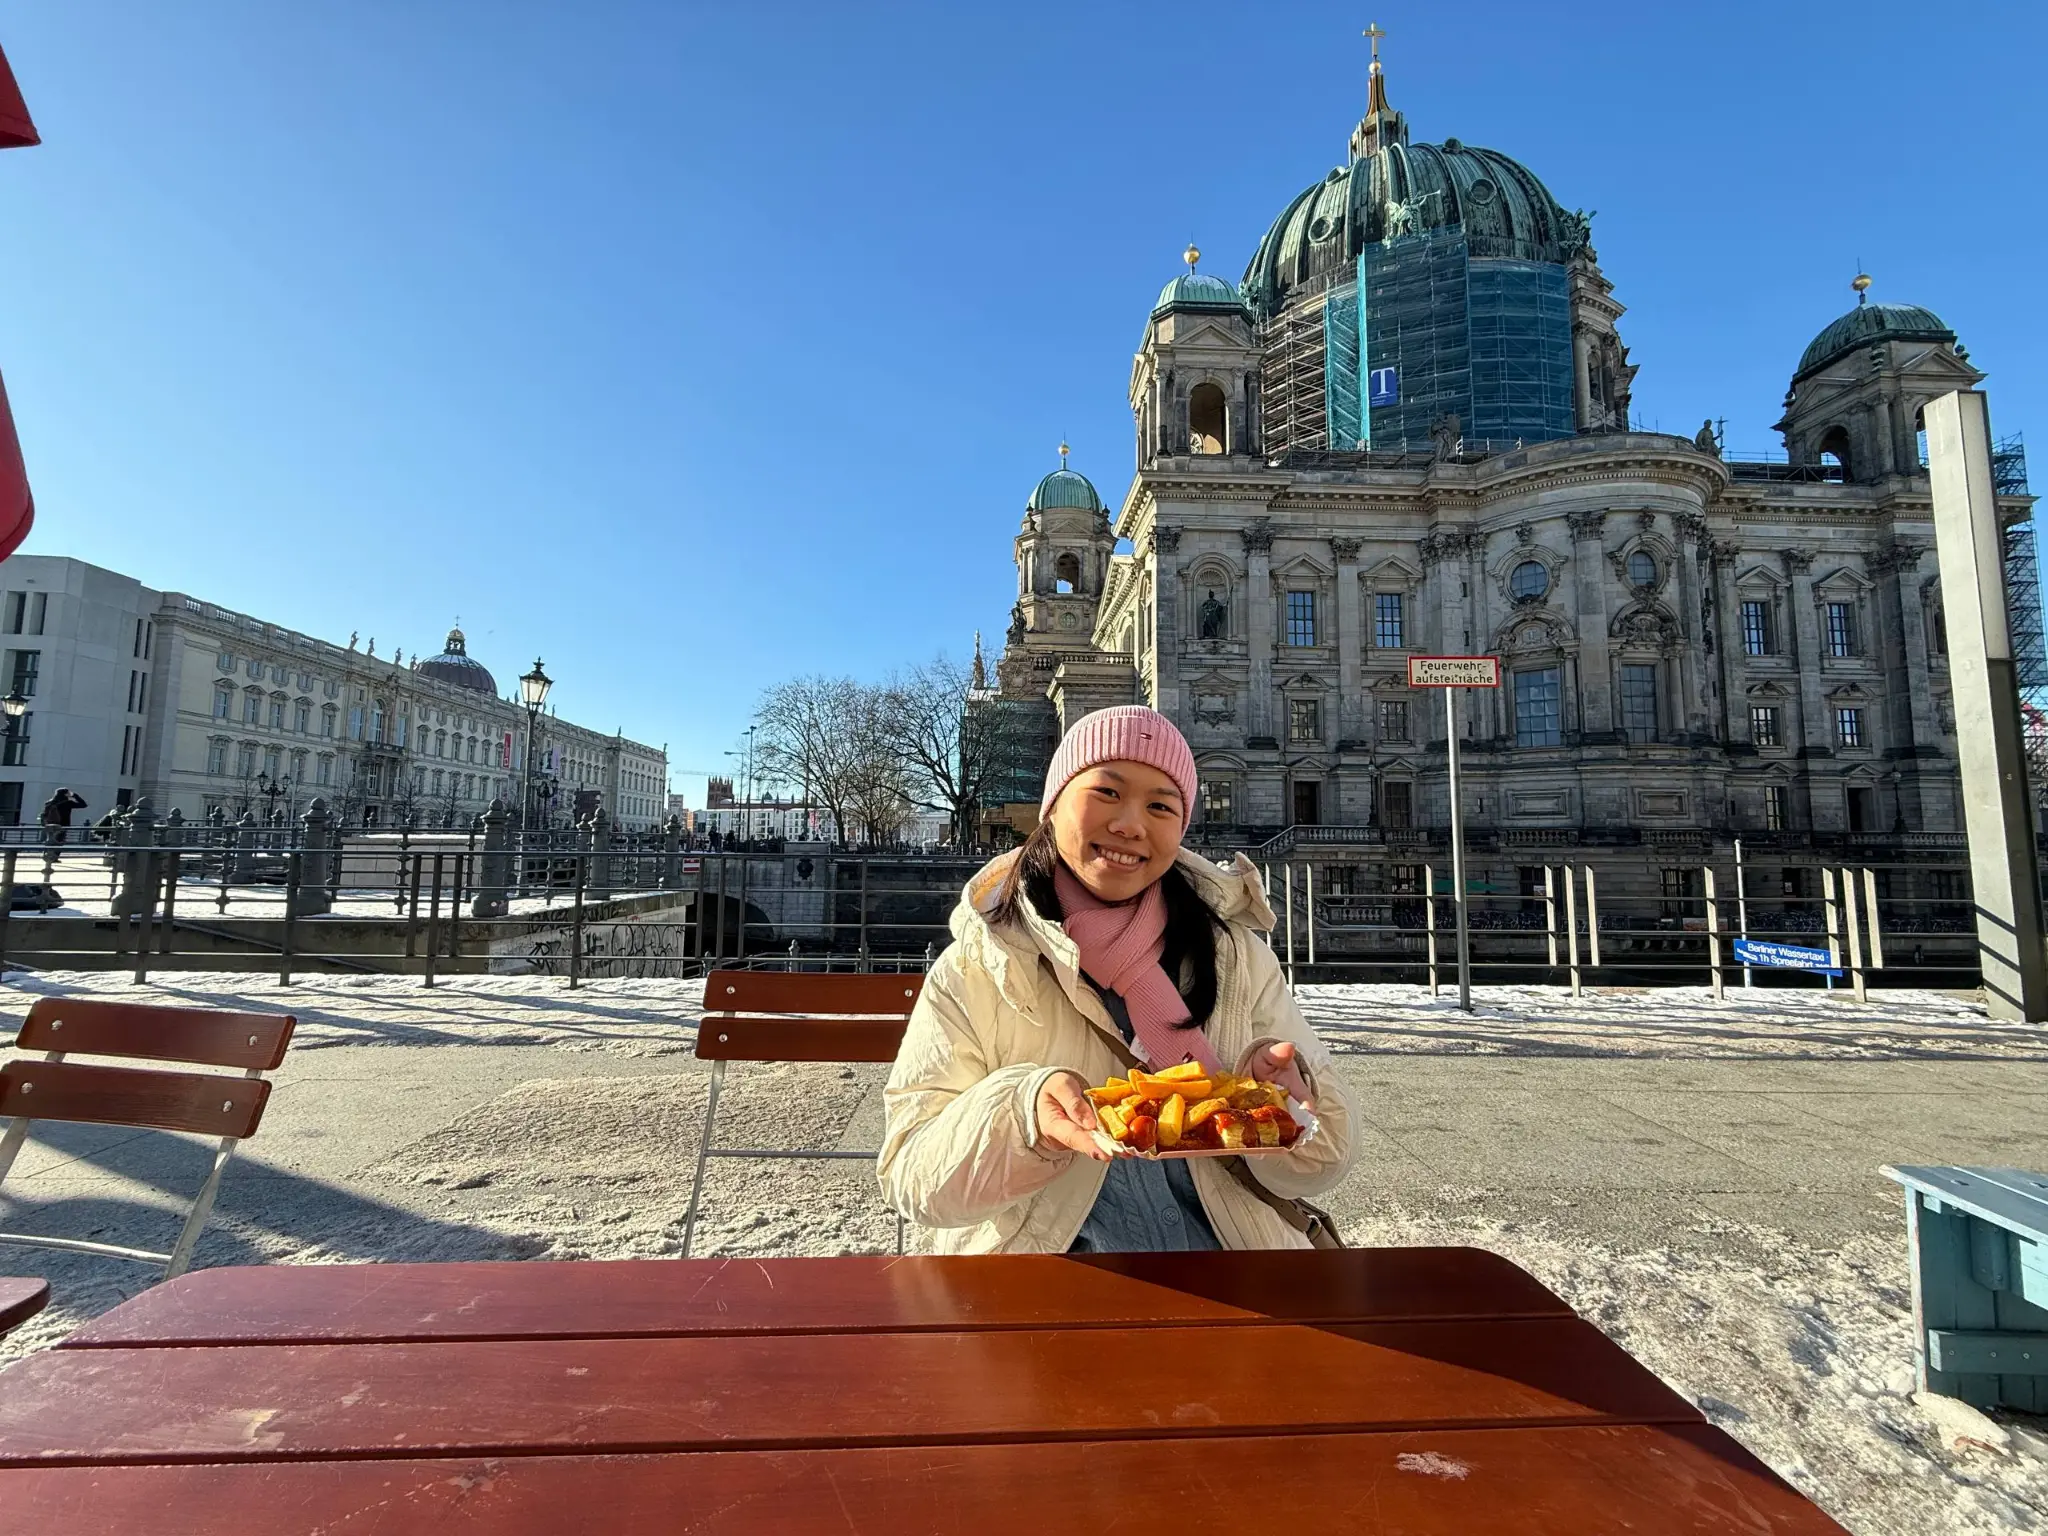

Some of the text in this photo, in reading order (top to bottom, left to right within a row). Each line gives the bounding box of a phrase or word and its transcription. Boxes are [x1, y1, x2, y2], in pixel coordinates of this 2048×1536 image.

[1370, 367, 1394, 395] T
[1420, 661, 1487, 670] Feuerwehr-
[1747, 943, 1777, 955] Berliner
[1778, 947, 1825, 961] Wassertaxi
[1759, 954, 1770, 963] 1h
[1770, 955, 1813, 968] Spreefahrt
